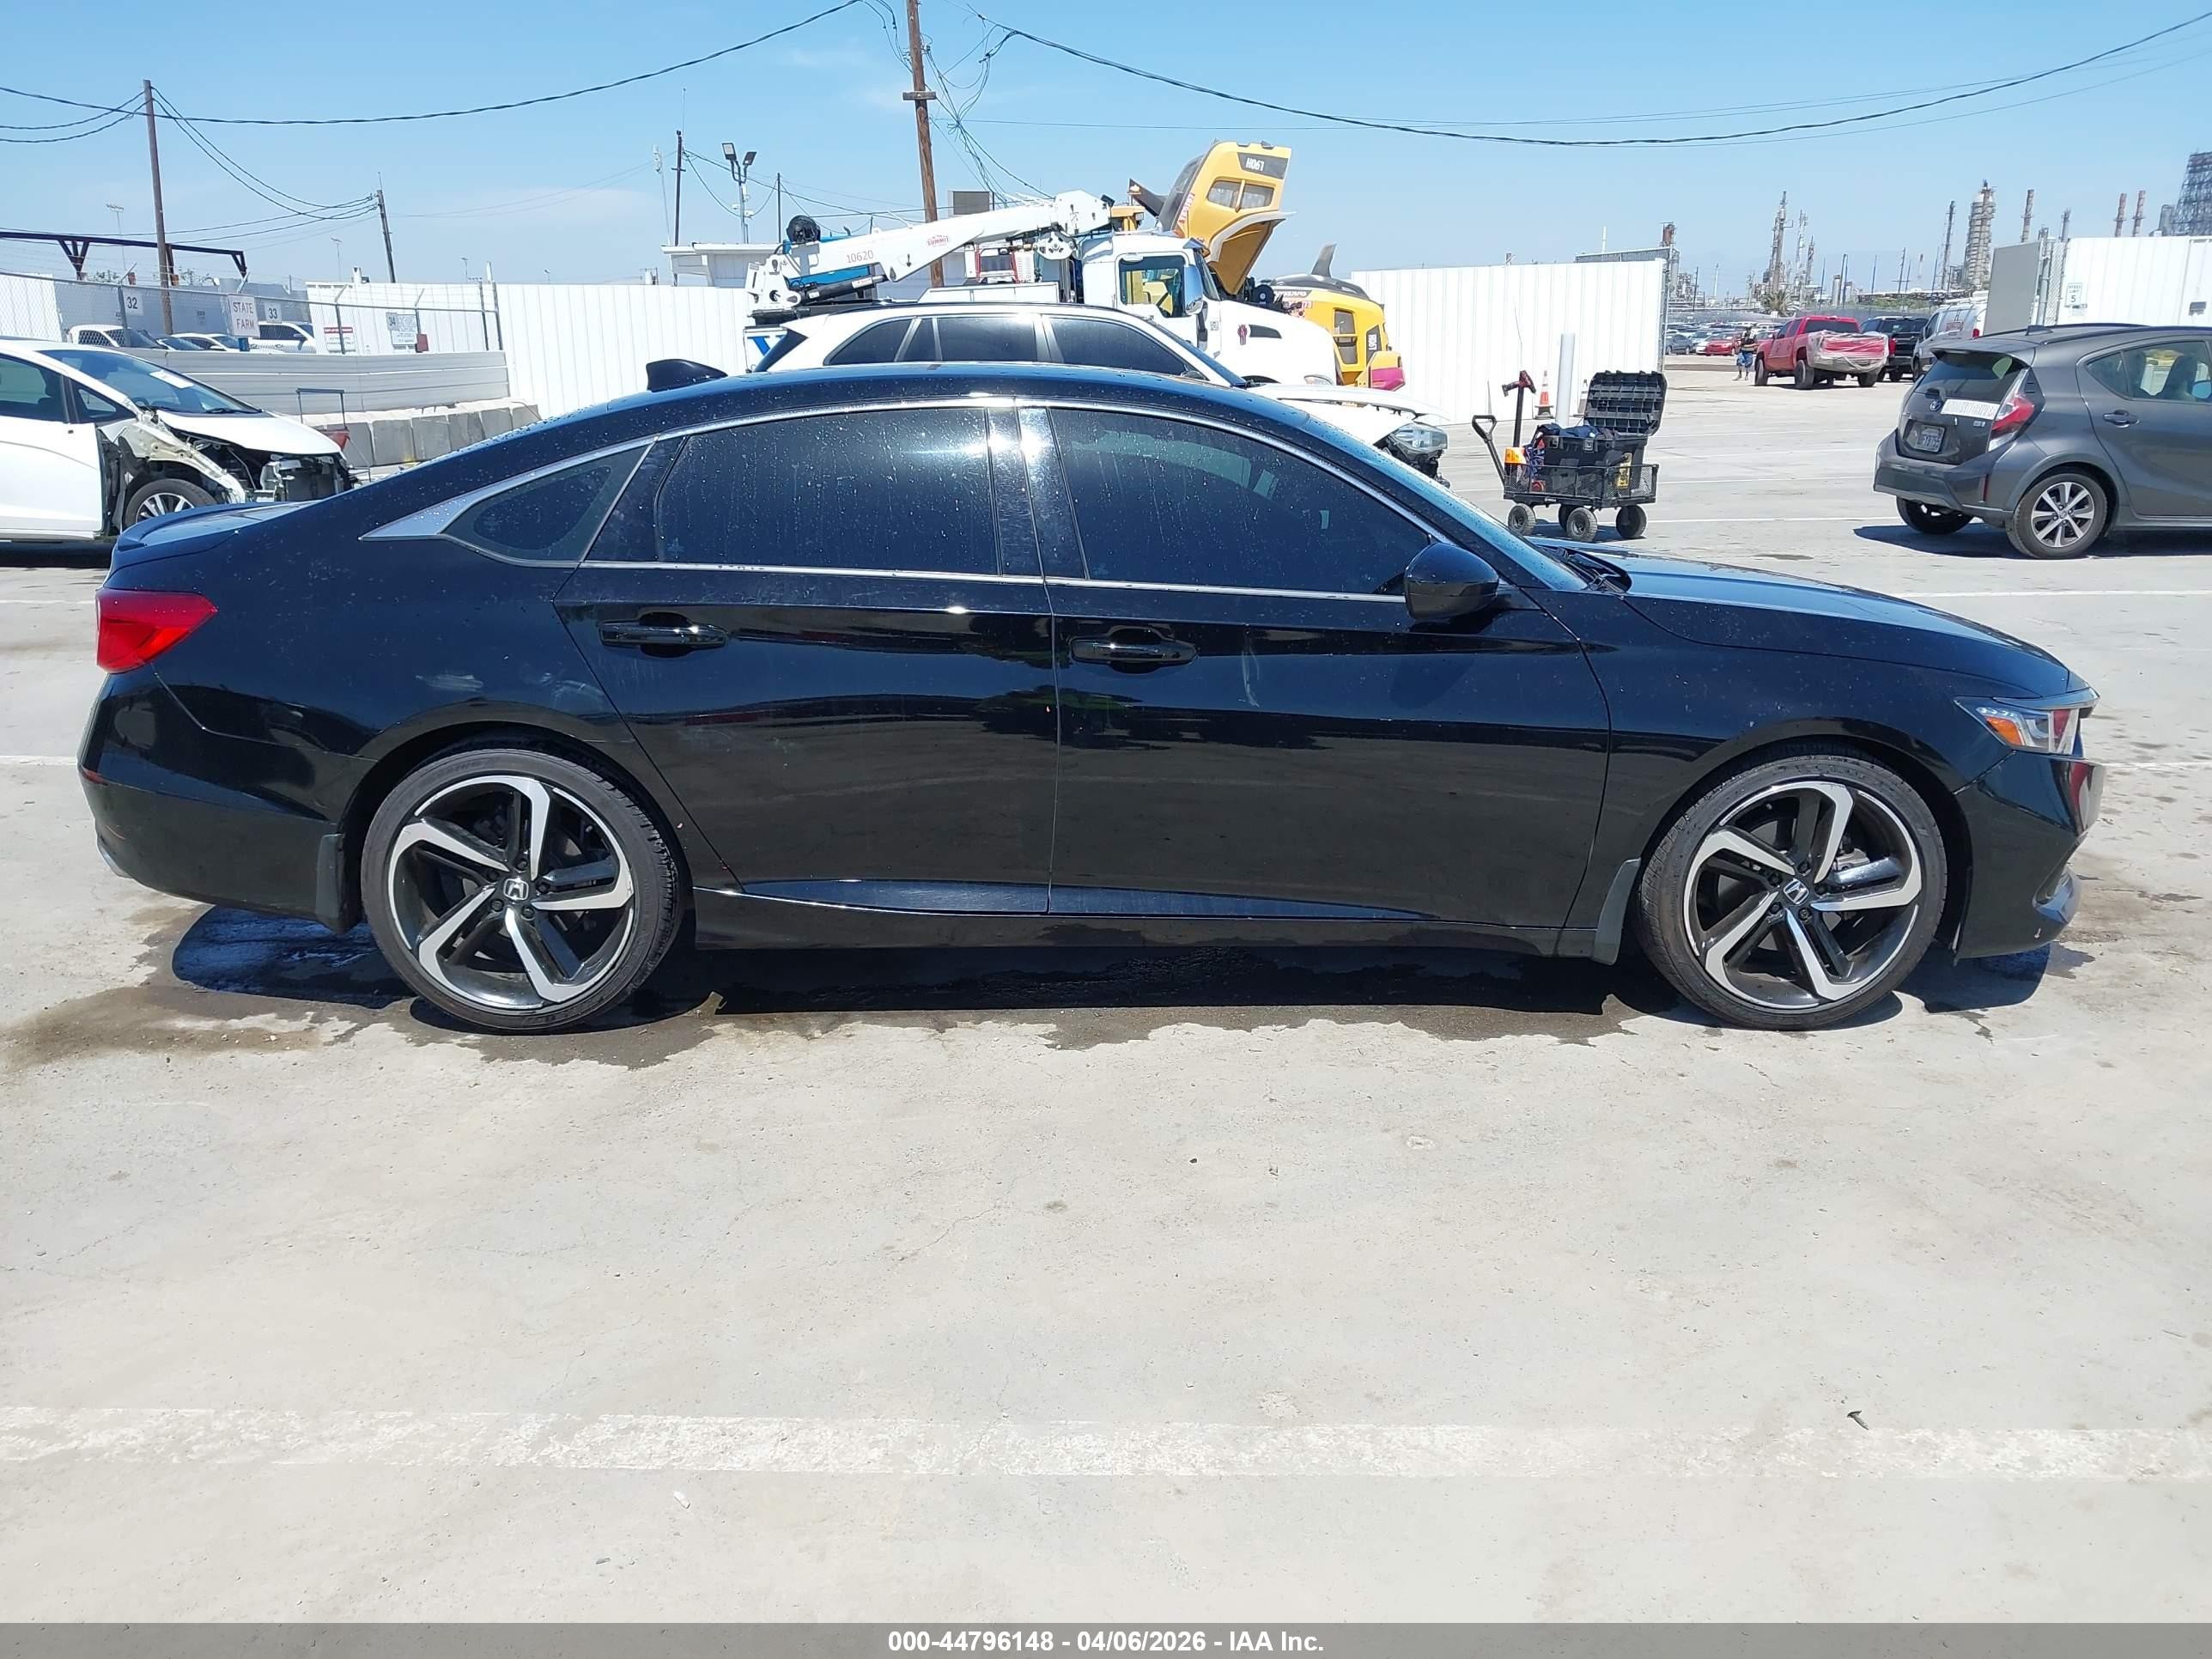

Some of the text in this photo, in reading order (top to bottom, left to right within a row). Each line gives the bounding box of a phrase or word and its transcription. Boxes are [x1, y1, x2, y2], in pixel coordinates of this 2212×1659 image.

[846, 250, 874, 264] 10620
[126, 296, 138, 310] 32
[233, 301, 254, 314] STATE
[268, 307, 278, 319] 33
[236, 318, 255, 330] FARM
